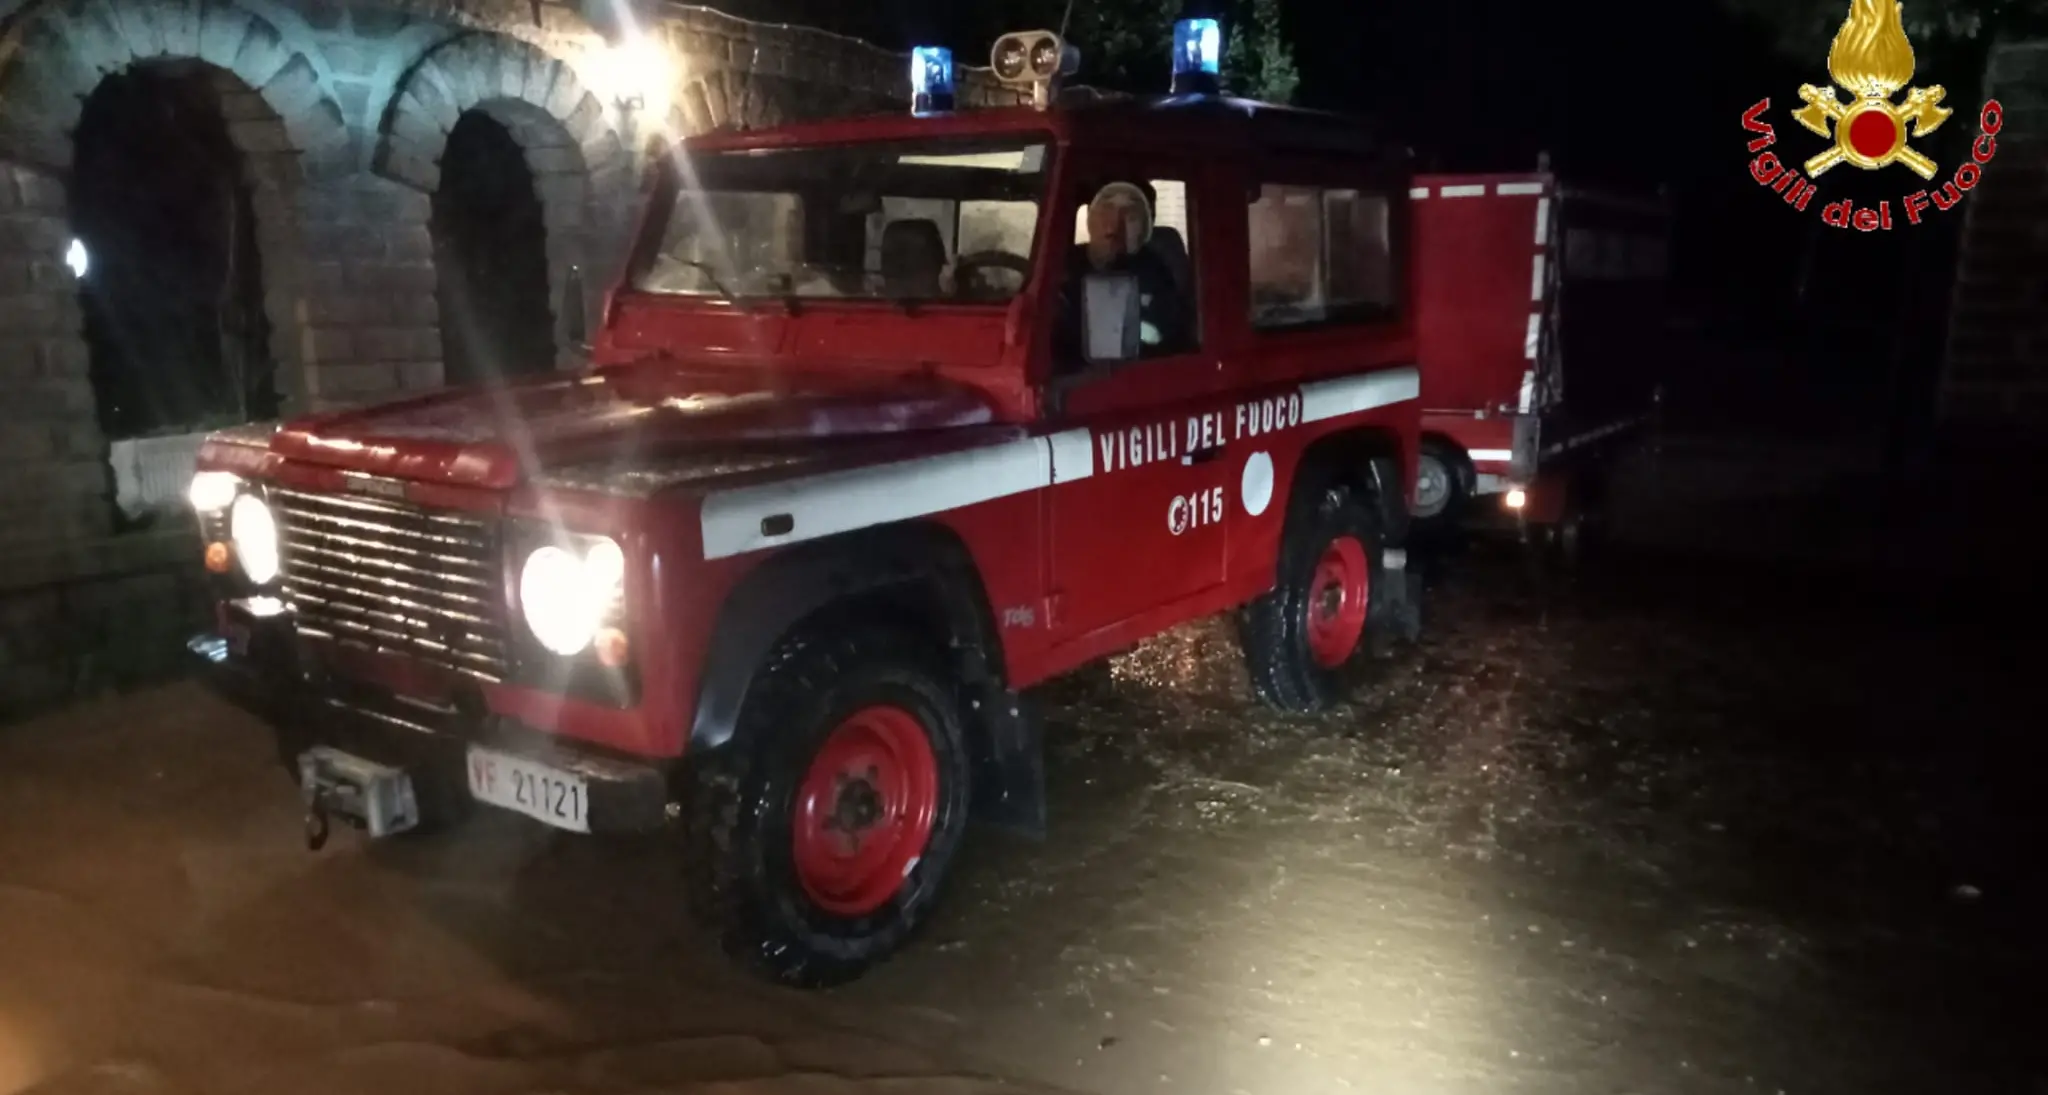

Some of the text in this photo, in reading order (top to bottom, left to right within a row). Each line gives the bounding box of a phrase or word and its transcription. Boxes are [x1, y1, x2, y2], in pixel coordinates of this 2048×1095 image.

[1100, 394, 1299, 473] VIGILI DEL FUOCO
[1189, 486, 1223, 528] 115
[473, 756, 579, 822] VF 21121
